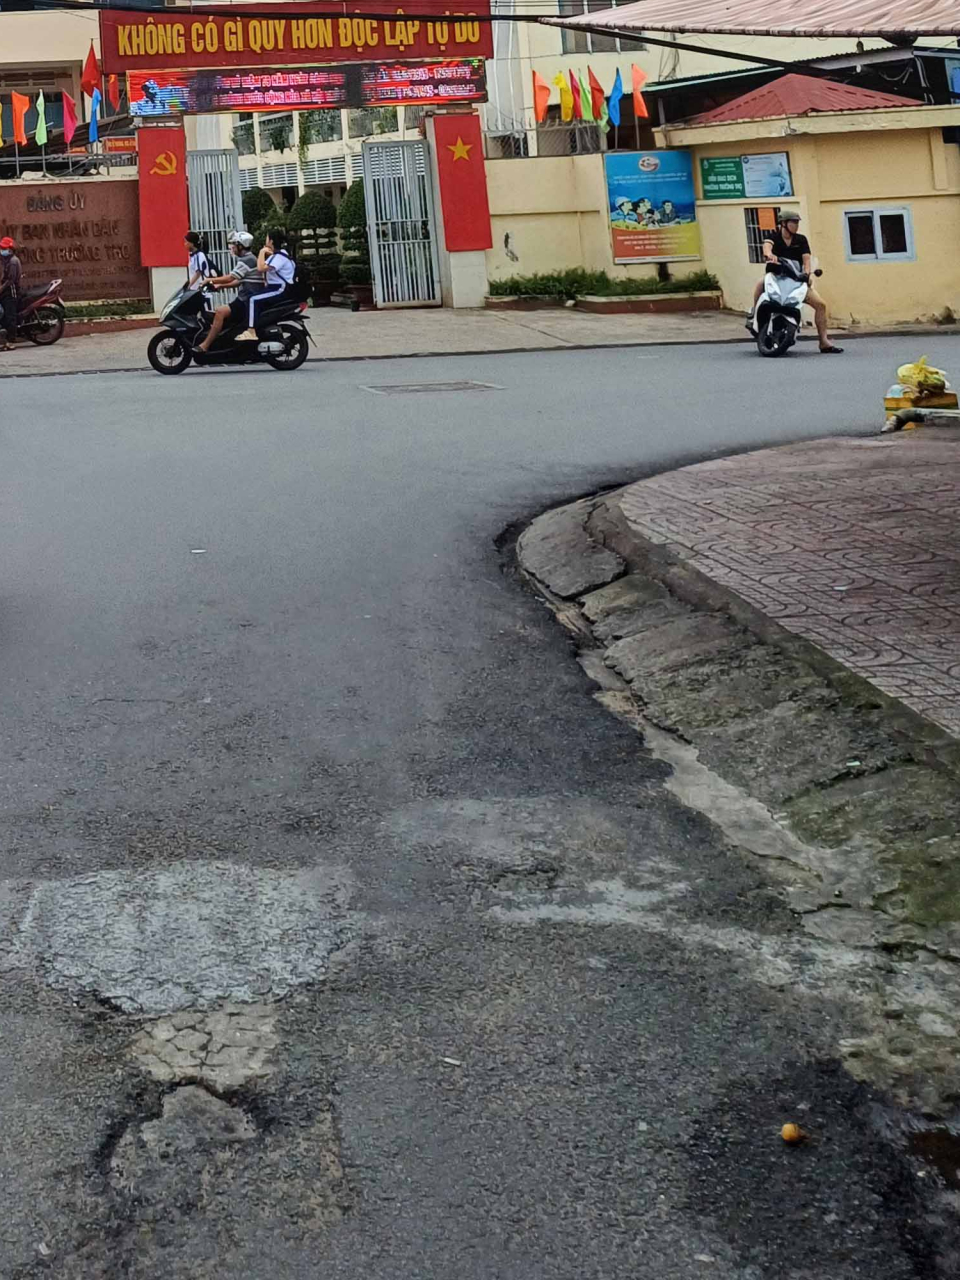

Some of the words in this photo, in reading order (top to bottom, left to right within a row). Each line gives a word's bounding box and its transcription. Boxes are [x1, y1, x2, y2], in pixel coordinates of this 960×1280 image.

[118, 17, 186, 56] KHÔNG
[191, 16, 218, 53] CÓ
[223, 16, 244, 52] GÌ
[383, 8, 421, 51] LẬP
[453, 12, 480, 43] DO
